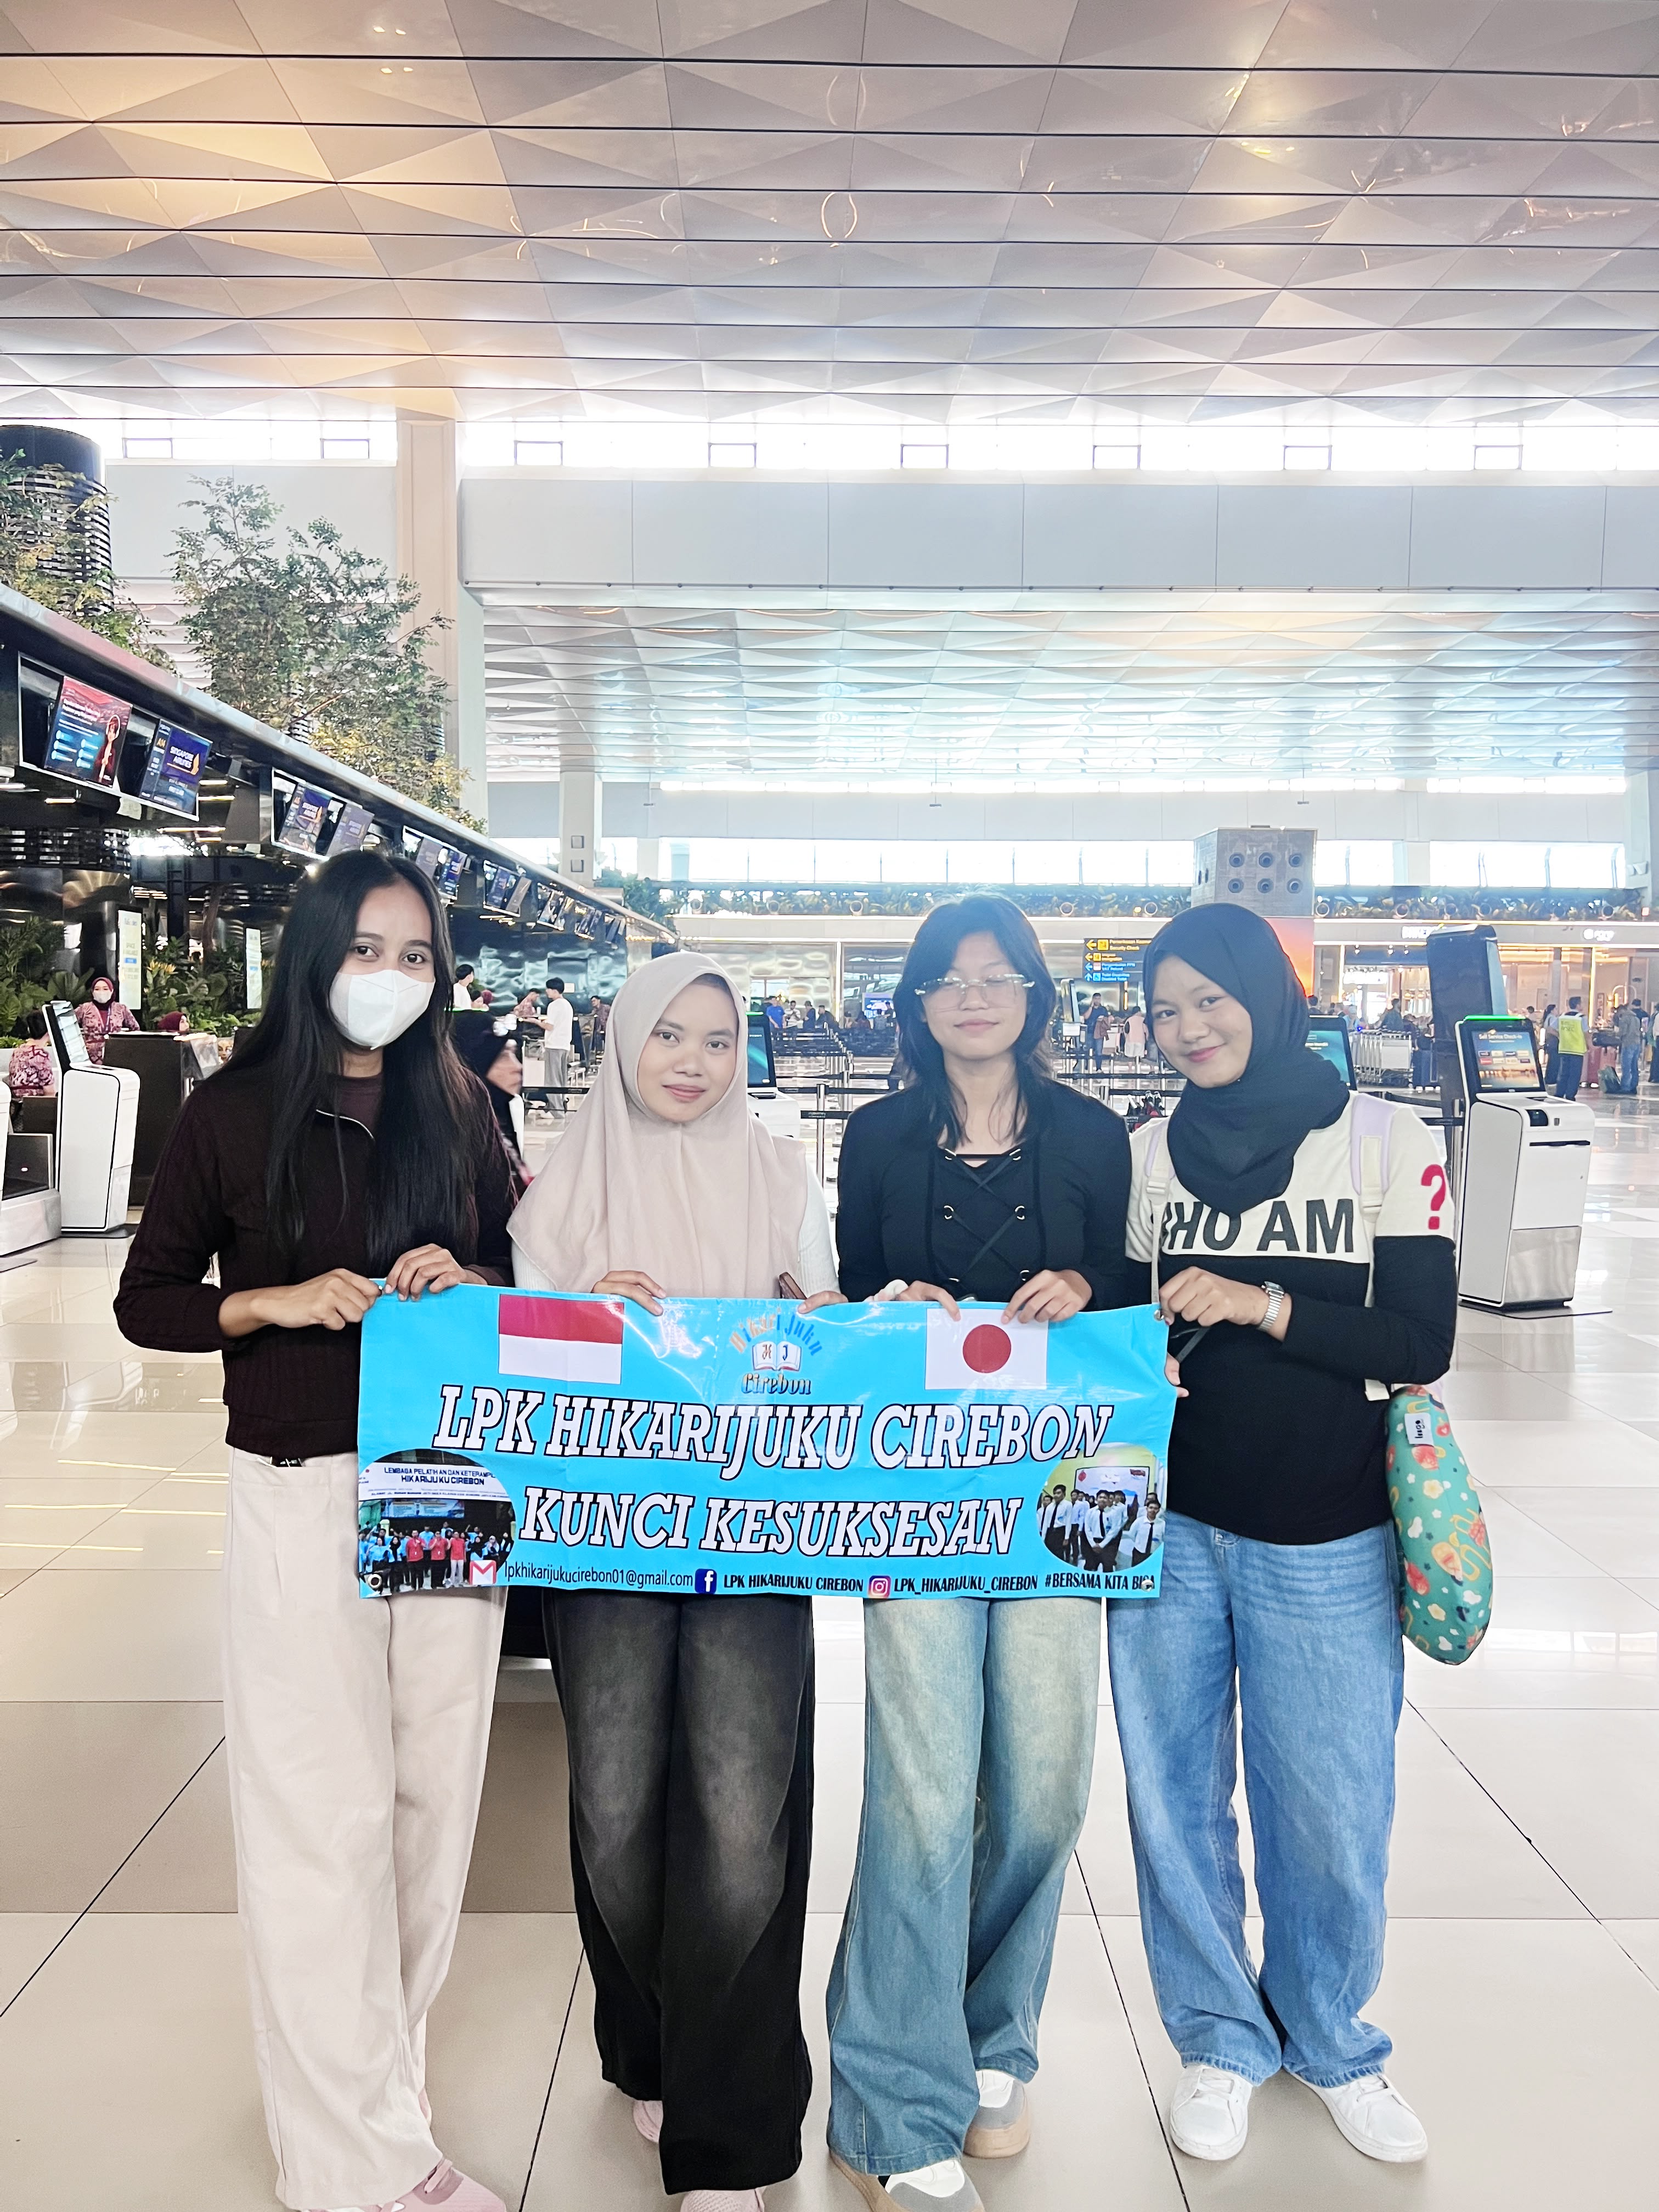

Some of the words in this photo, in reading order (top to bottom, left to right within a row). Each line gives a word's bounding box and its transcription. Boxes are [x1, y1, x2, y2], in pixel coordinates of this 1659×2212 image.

[1256, 1198, 1354, 1254] AM
[741, 1373, 812, 1395] Cirebon
[432, 1384, 545, 1454] LPK
[545, 1392, 864, 1480] HIKARIJUKU
[870, 1403, 1115, 1470] CIREBON
[450, 1476, 484, 1486] CIREBON
[519, 1485, 695, 1549] KUNCI
[699, 1497, 1025, 1559] KESUKSESAN
[505, 1561, 693, 1589] lpkhikarijukucirebon01@gmail.com
[724, 1575, 745, 1588] LPK
[748, 1573, 812, 1589] HIKARIJUKU
[816, 1576, 864, 1592] CIREBON
[894, 1574, 1038, 1595] LPK_HIKARIJUKU_CIREBON
[1045, 1572, 1101, 1589] #BERSAMA
[1104, 1574, 1128, 1590] KITA
